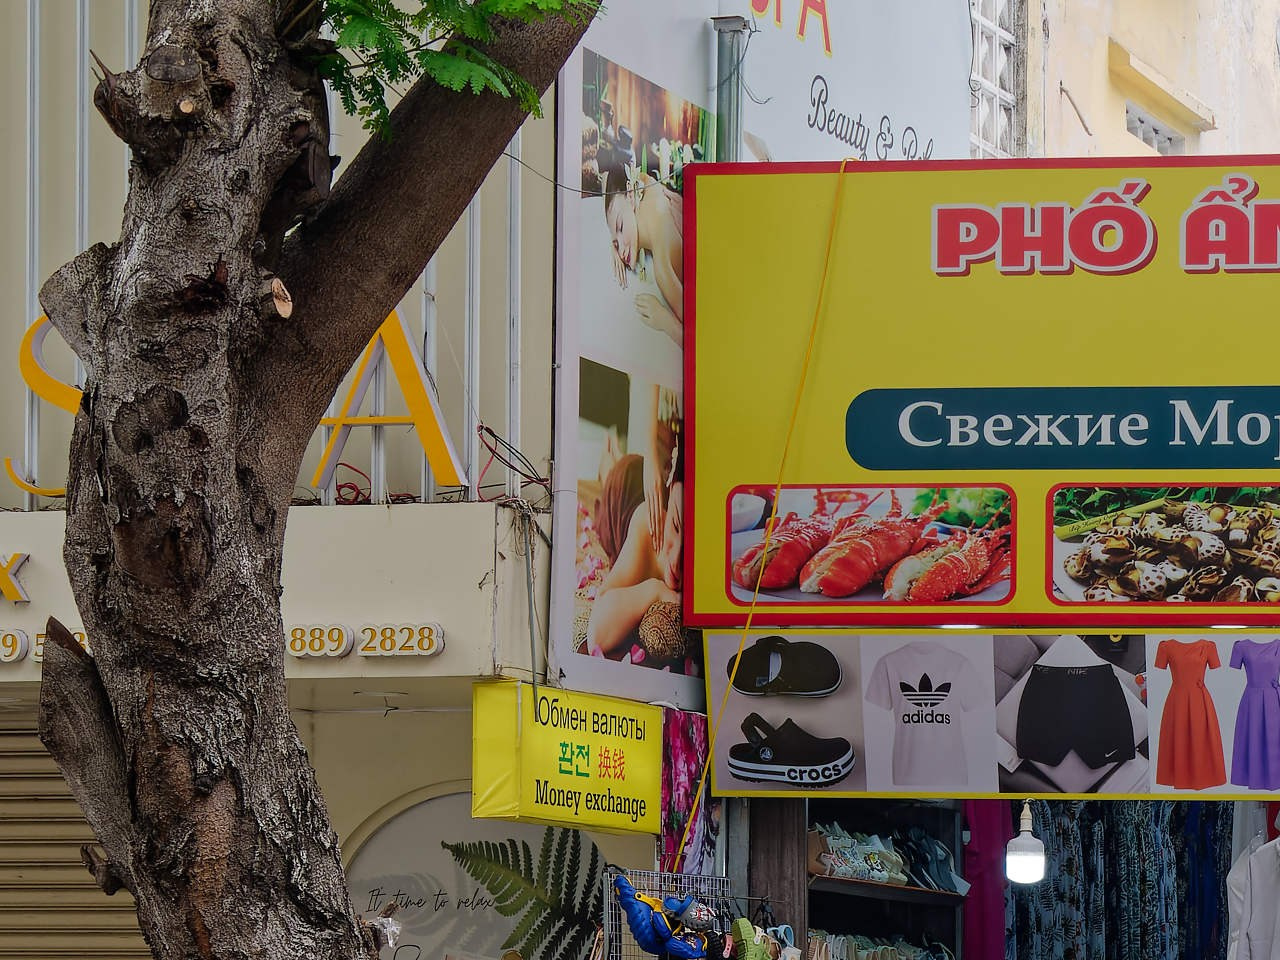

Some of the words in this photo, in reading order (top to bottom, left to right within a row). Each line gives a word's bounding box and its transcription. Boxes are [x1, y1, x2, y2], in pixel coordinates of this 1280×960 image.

[808, 75, 870, 160] Beauty
[876, 115, 894, 160] &
[931, 177, 1158, 276] PHỐ
[897, 401, 1149, 449] Свежие
[290, 626, 345, 653] 889
[360, 625, 435, 653] 2828
[537, 696, 587, 731] Обмен
[592, 712, 646, 741] валюты
[902, 710, 951, 724] adidas
[558, 741, 590, 777] 환전
[598, 746, 626, 782] 换钱
[787, 764, 842, 781] crocs
[535, 779, 582, 815] Money
[585, 789, 646, 822] exchange
[393, 889, 426, 908] time
[434, 889, 449, 912] to
[457, 888, 496, 911] relax
